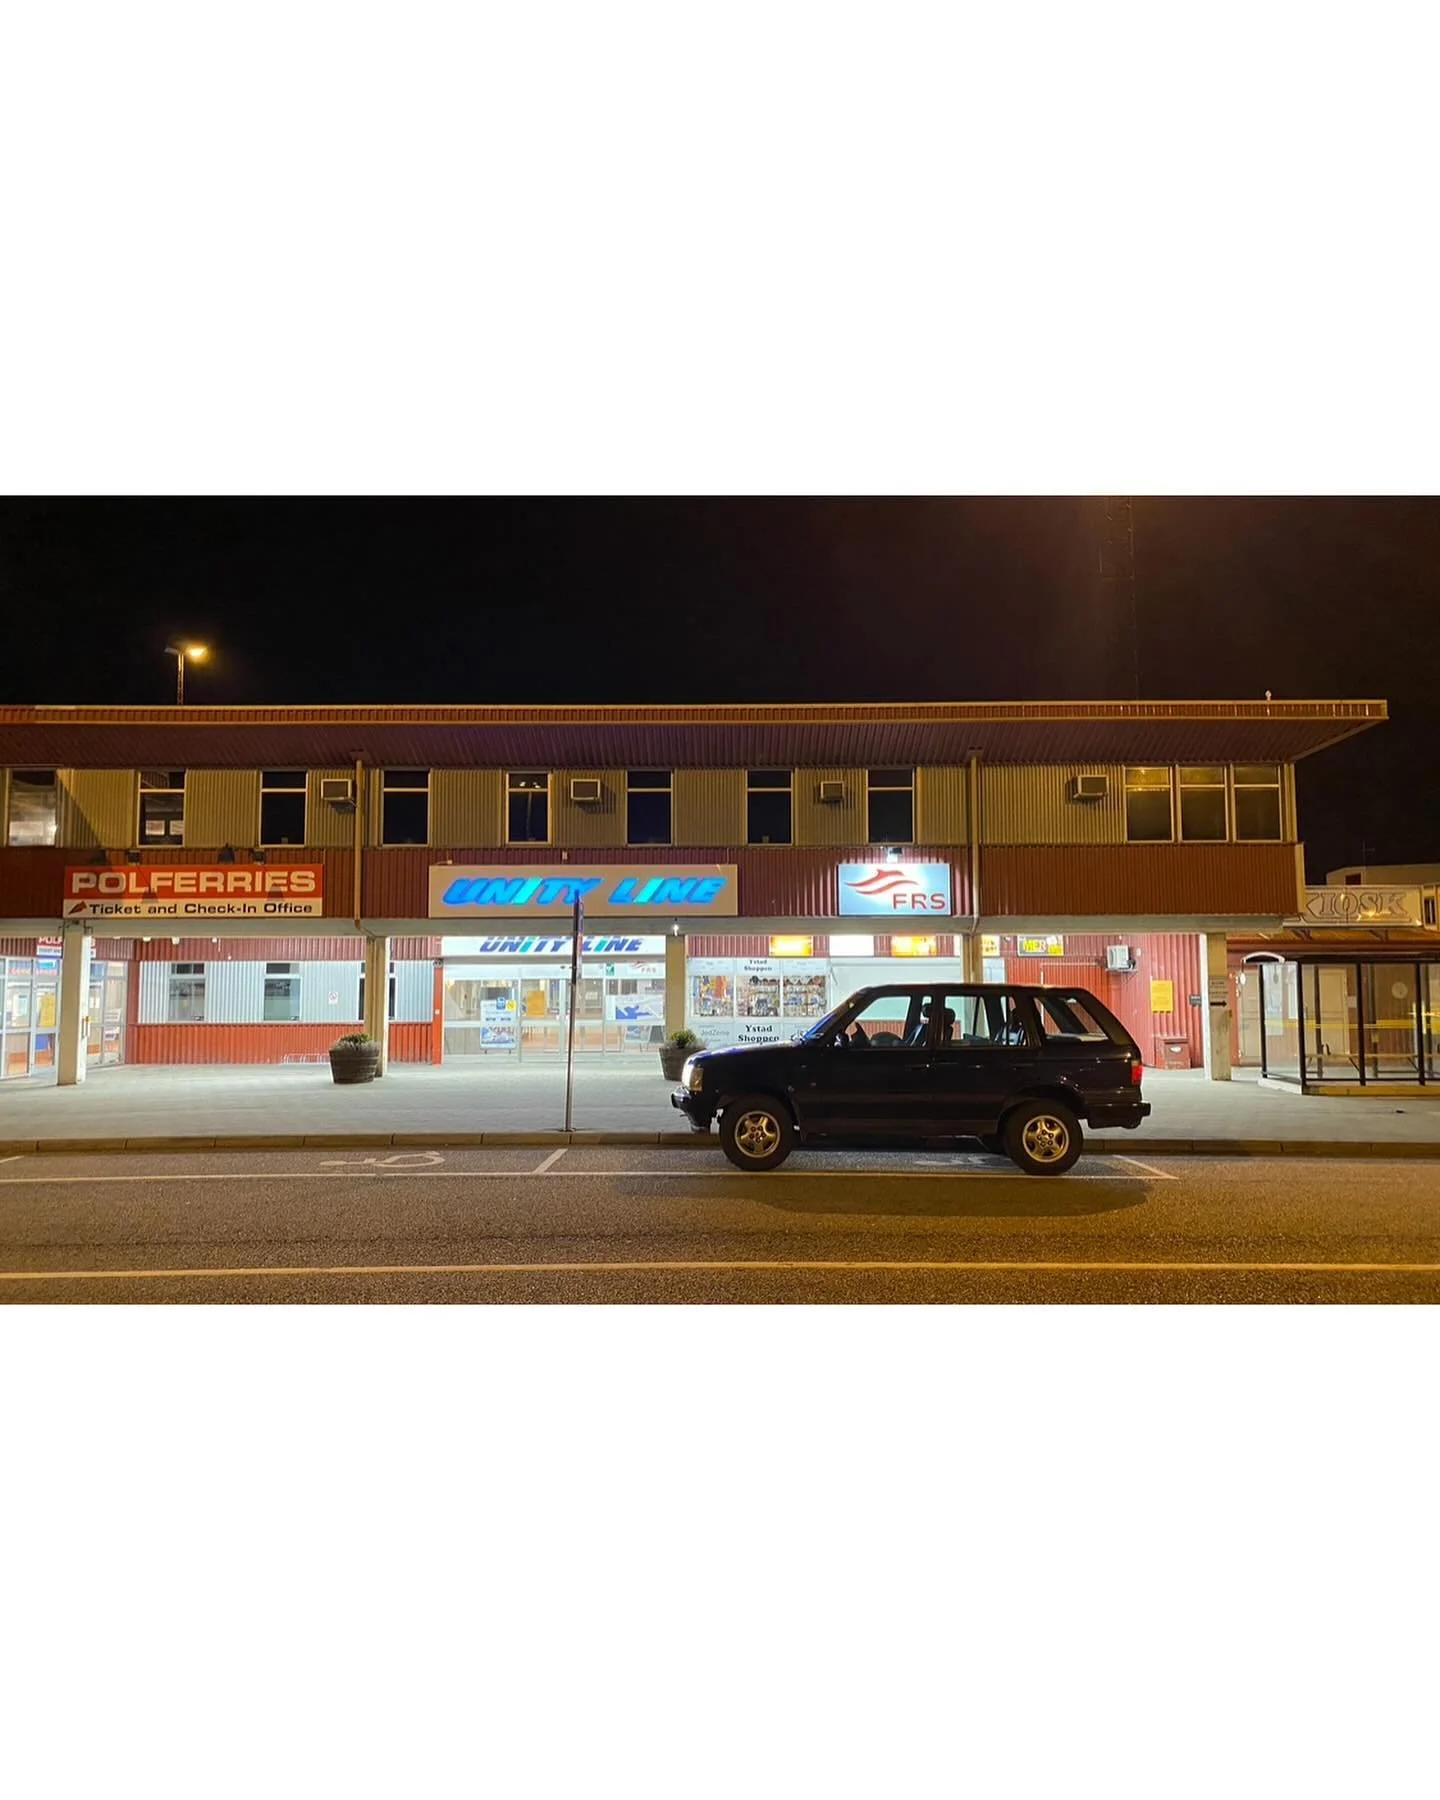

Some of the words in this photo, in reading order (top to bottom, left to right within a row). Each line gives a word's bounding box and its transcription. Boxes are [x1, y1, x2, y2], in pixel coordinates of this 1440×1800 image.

[71, 871, 315, 893] POLFERRIES
[441, 876, 603, 905] UNITY
[608, 876, 728, 905] LINE
[89, 903, 141, 915] Ticket
[148, 903, 177, 914] and
[184, 902, 257, 915] Check-In
[264, 902, 313, 914] Office
[893, 893, 946, 910] FRS
[745, 1024, 773, 1033] Ystad
